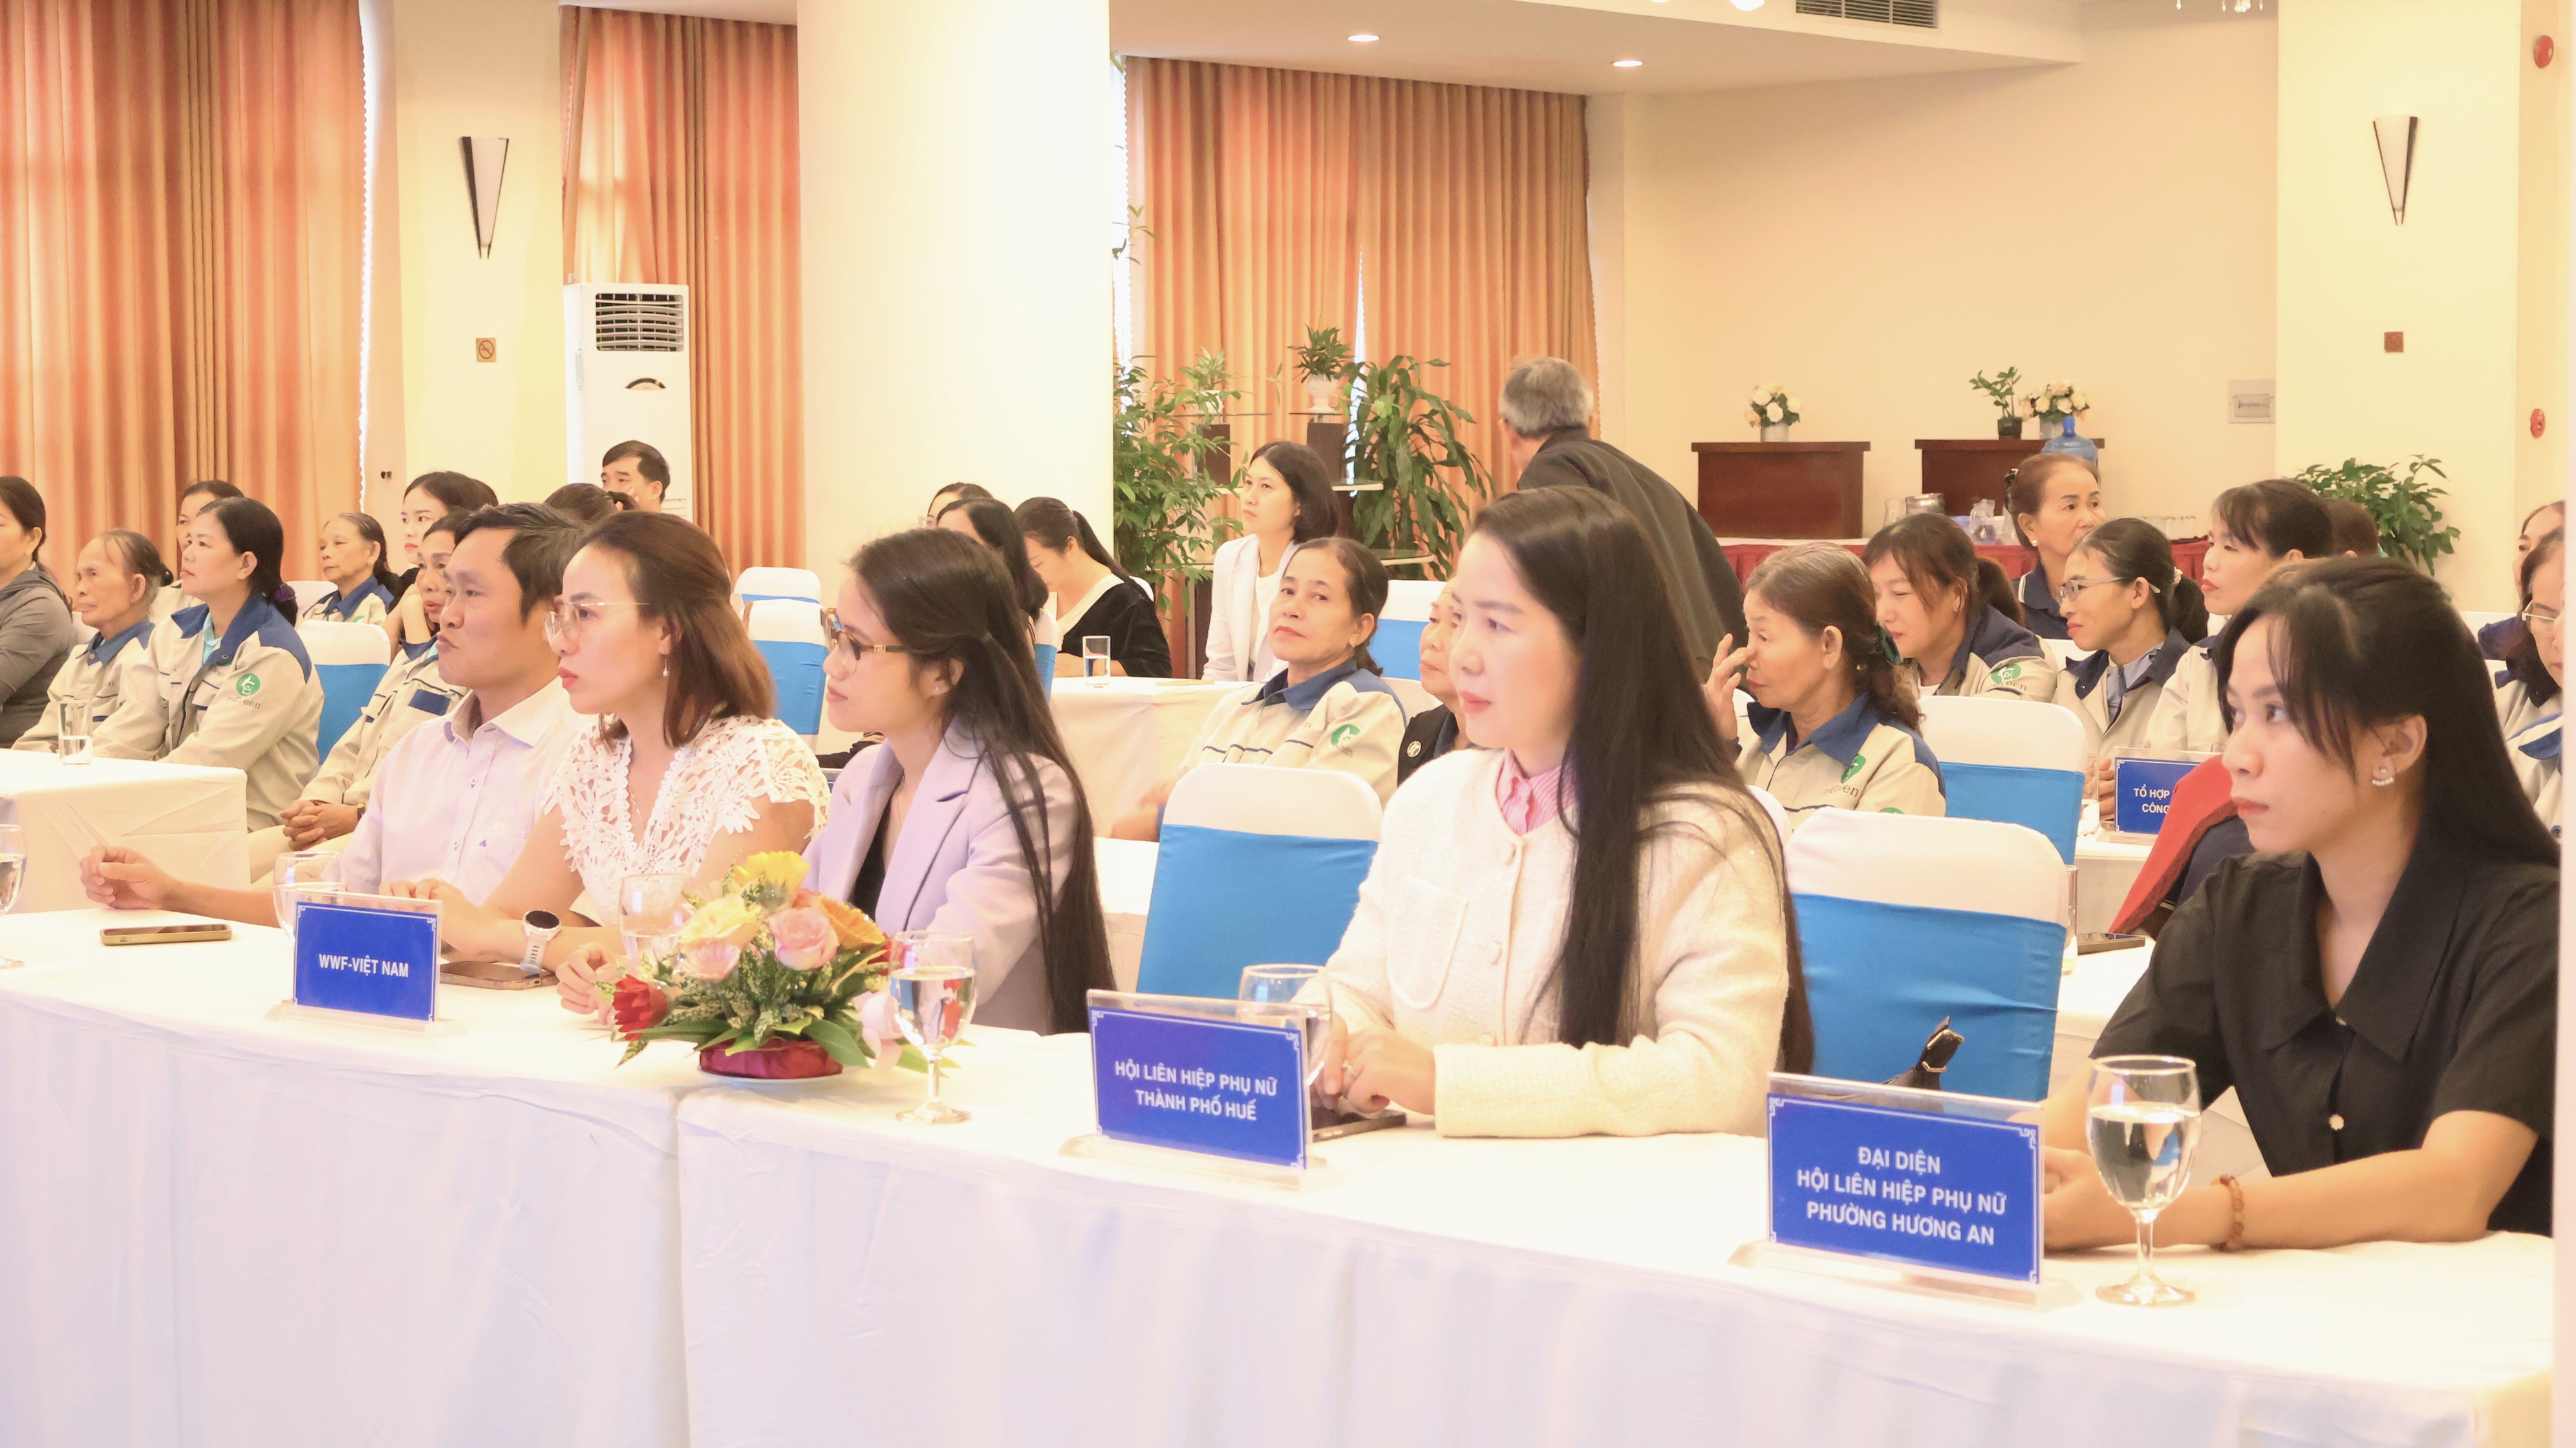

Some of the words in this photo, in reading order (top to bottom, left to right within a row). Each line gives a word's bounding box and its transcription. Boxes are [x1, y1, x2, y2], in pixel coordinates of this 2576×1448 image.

[2134, 784, 2147, 797] TỔ
[2150, 789, 2170, 800] HỢP
[2142, 802, 2170, 813] CÔNG
[319, 954, 378, 975] WWF-VIỆT
[382, 961, 409, 977] NAM
[1115, 1059, 1139, 1080] HỘI
[1144, 1063, 1176, 1083] LIÊN
[1181, 1068, 1215, 1089] HIỆP
[1220, 1075, 1250, 1095] PHỤ
[1255, 1077, 1277, 1096] NỮ
[1136, 1089, 1185, 1111] THÀNH
[1190, 1094, 1221, 1116] PHỐ
[1226, 1100, 1256, 1120] HUẾ
[1858, 1147, 1889, 1170] ĐẠI
[1896, 1150, 1940, 1175] DIỆN
[1797, 1167, 1829, 1192] HỘI
[1834, 1172, 1875, 1197] LIÊN
[1883, 1179, 1926, 1205] HIỆP
[1933, 1188, 1971, 1213] PHỤ
[1978, 1192, 2006, 1215] NỮ
[1807, 1201, 1885, 1229] PHƯỜNG
[1893, 1213, 1960, 1240] HƯƠNG
[1967, 1225, 1994, 1245] AN
